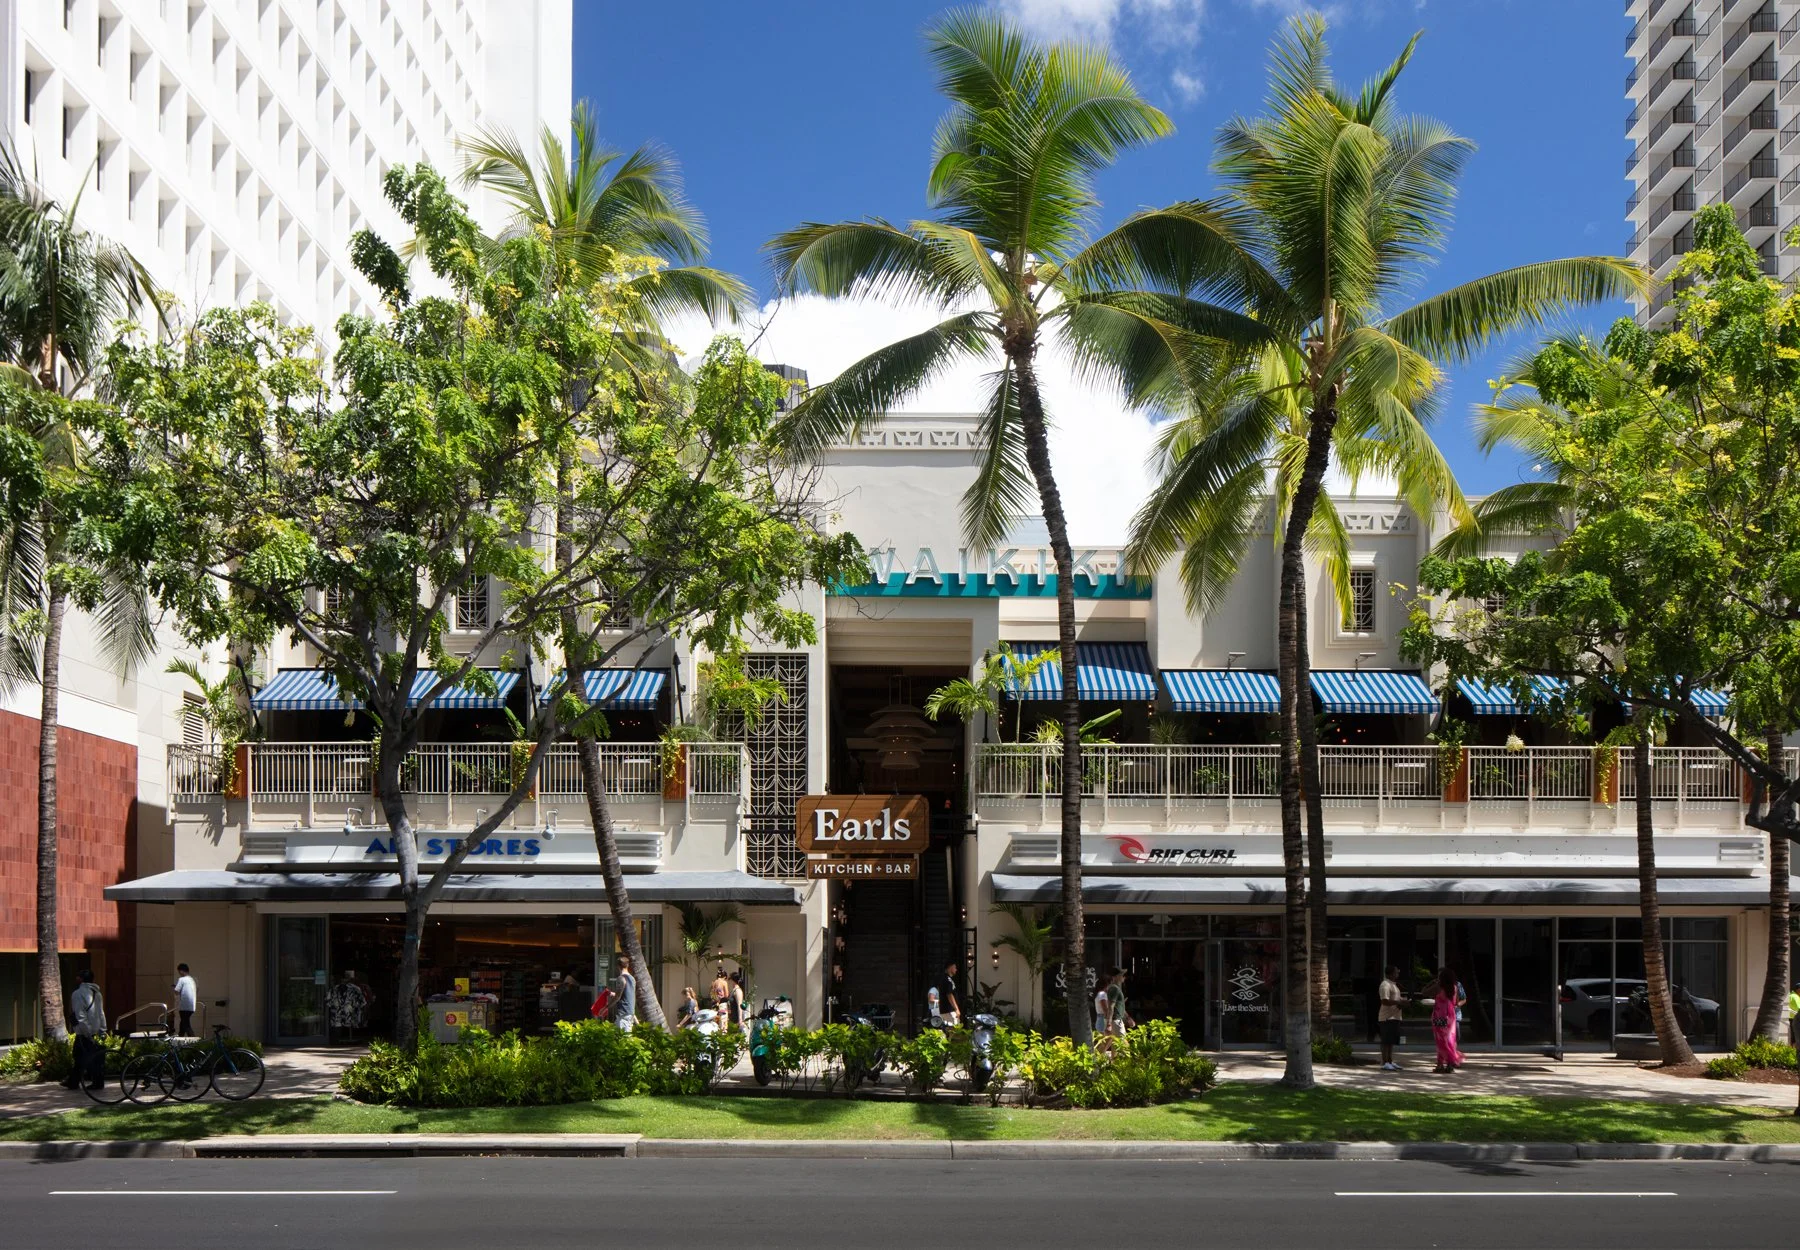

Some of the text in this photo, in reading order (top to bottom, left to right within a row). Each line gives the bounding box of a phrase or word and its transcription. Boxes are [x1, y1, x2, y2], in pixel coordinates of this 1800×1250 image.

[814, 807, 911, 841] Earls
[1149, 848, 1237, 859] RIP CURL
[814, 864, 873, 874] KITCHEN
[885, 864, 911, 874] BAR
[1237, 1003, 1248, 1012] the
